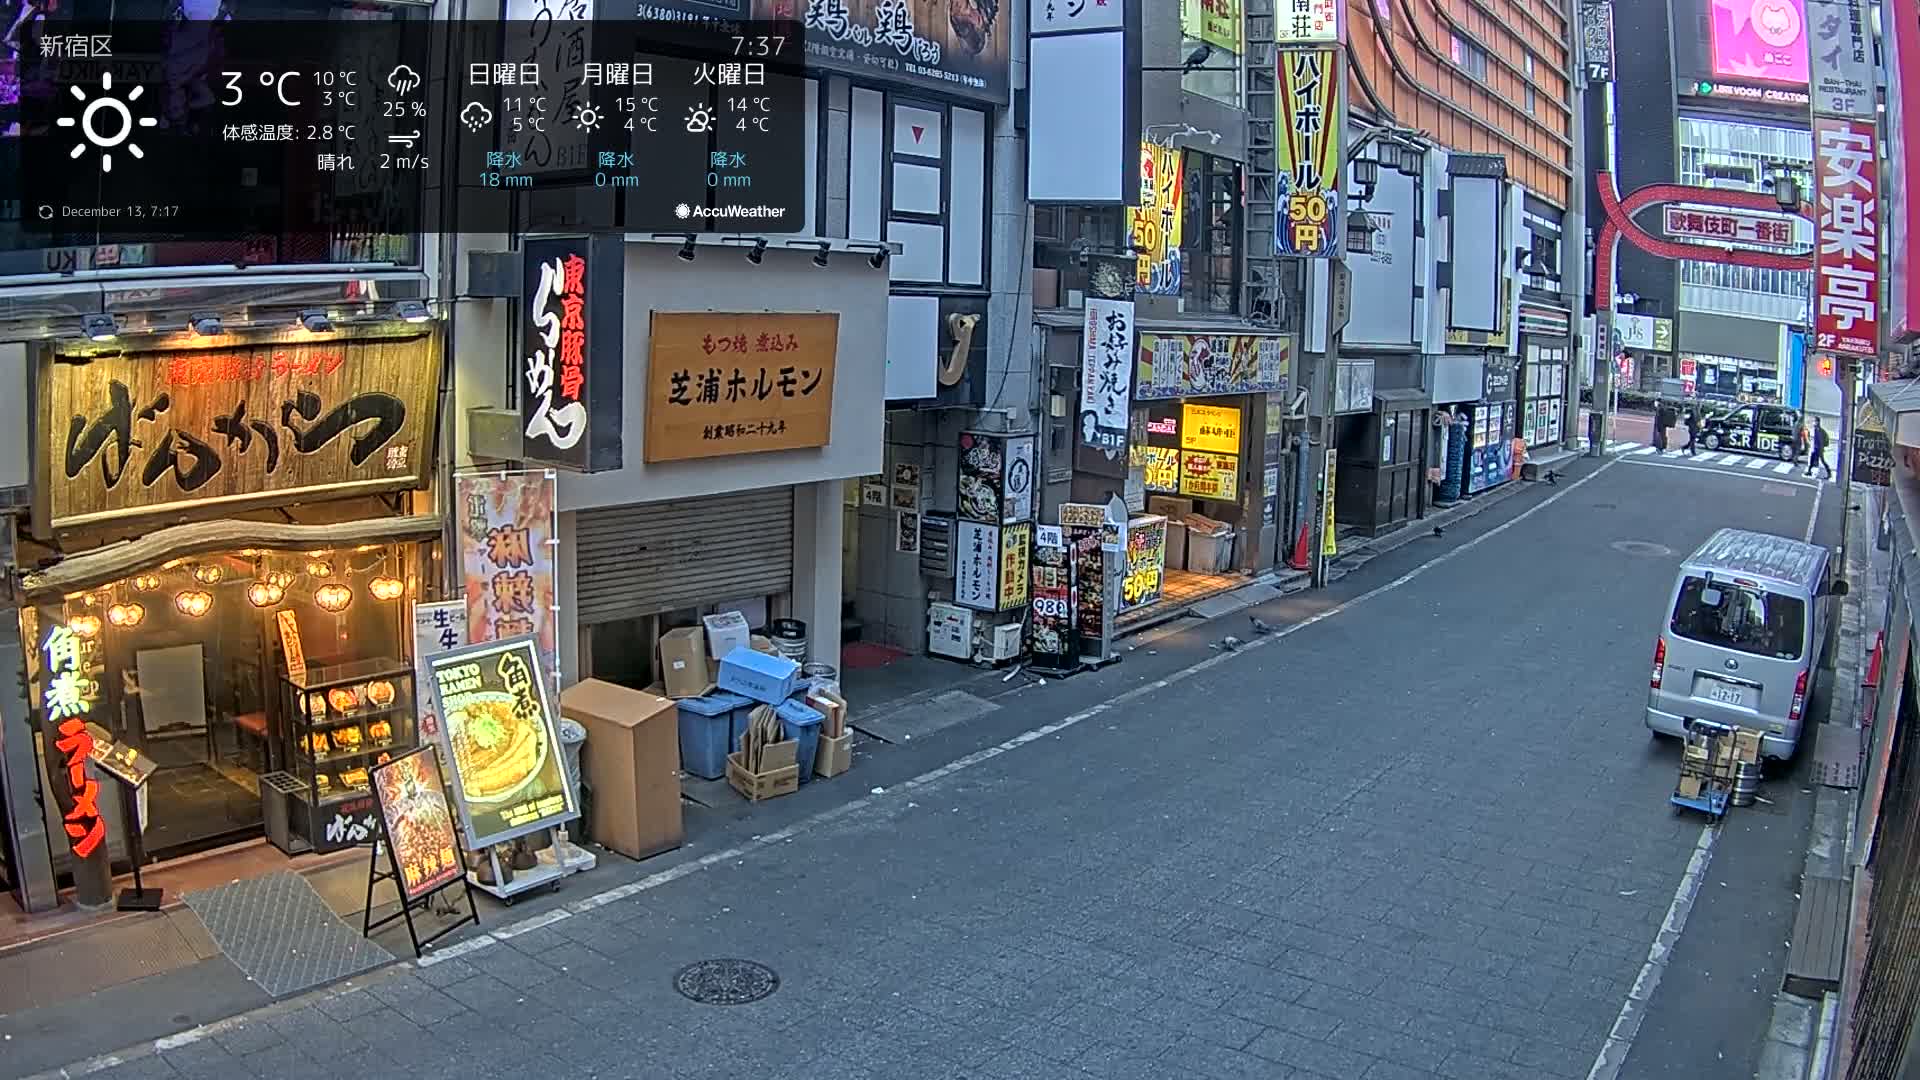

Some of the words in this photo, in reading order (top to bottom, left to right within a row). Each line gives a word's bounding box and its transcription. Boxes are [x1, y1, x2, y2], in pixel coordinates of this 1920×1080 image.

[1817, 14, 1842, 70] タイ
[1589, 64, 1609, 79] 7F
[1294, 53, 1324, 191] ハイボール
[1832, 97, 1855, 112] 3F
[1160, 151, 1175, 289] ハイボール
[1289, 194, 1327, 222] 50
[1133, 221, 1156, 250] 50
[1294, 224, 1319, 251] 円
[1669, 211, 1790, 242] 歌舞伎町一番街
[1819, 126, 1876, 330] 安楽亭
[560, 254, 586, 400] 東京豚骨
[1818, 333, 1836, 347] 2F
[1099, 309, 1128, 415] お好み焼き
[668, 366, 823, 406] 芝浦ホルモン
[1101, 433, 1125, 446] B1F
[42, 624, 90, 721] 角煮
[437, 664, 481, 683] TOKYO
[440, 676, 482, 696] RAMEN
[499, 653, 540, 719] 角煮
[56, 718, 105, 858] ラーメン
